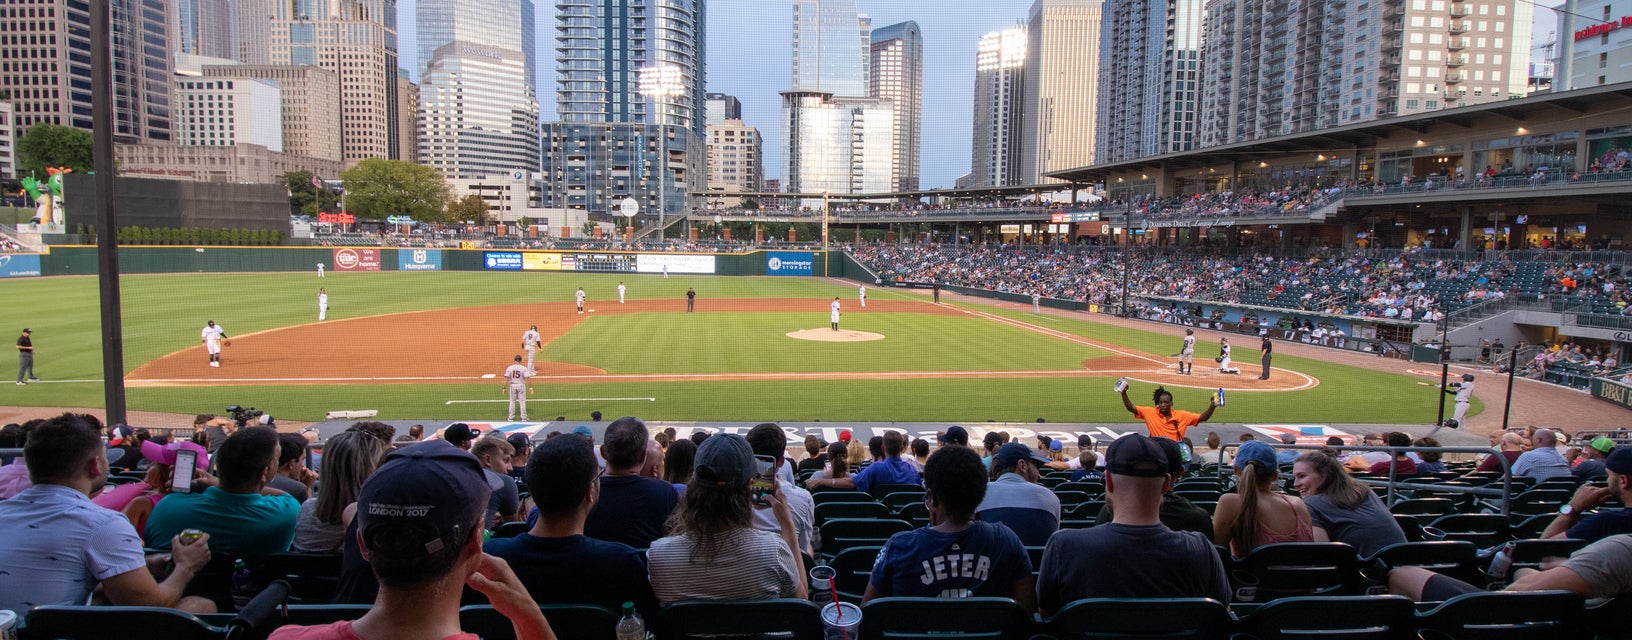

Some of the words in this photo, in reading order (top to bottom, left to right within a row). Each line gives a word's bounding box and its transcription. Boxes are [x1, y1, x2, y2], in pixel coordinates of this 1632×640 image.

[1574, 20, 1618, 42] esidence
[512, 370, 521, 379] 15
[1601, 382, 1627, 403] BB&T
[368, 506, 403, 517] LONDON
[406, 509, 429, 517] 2017
[920, 553, 991, 585] JETER
